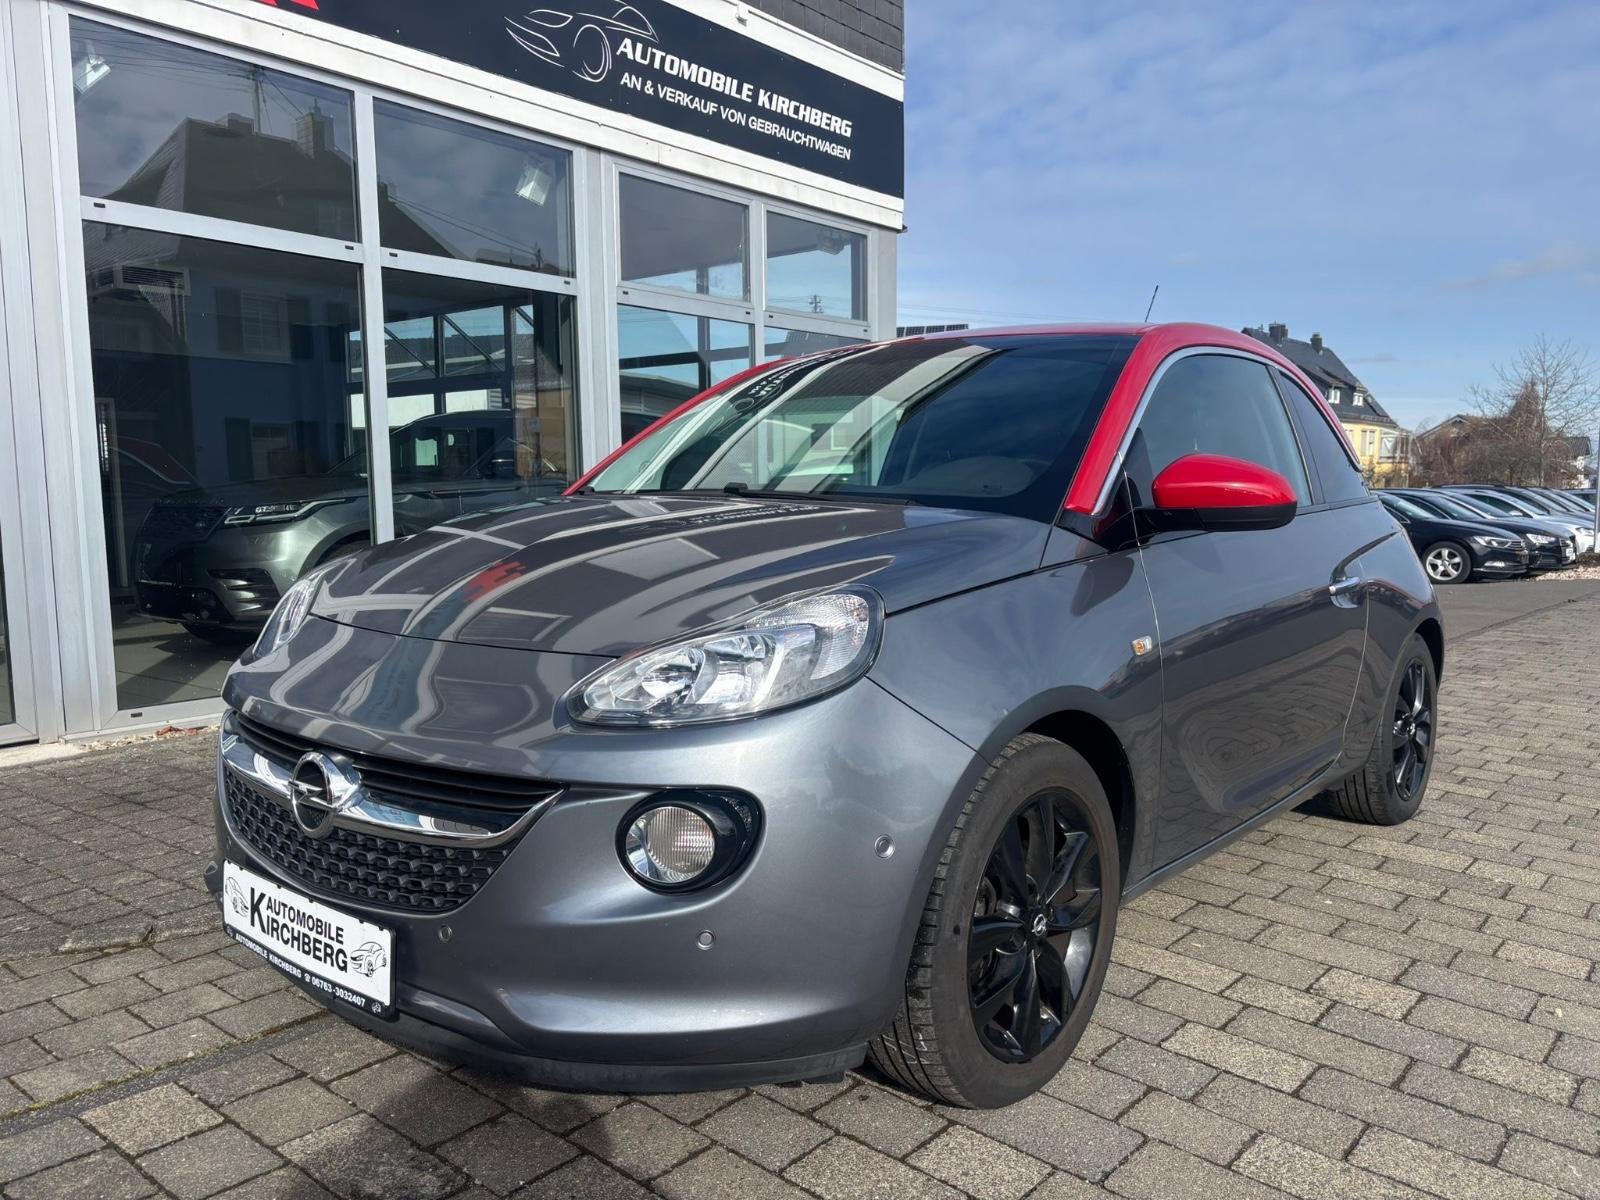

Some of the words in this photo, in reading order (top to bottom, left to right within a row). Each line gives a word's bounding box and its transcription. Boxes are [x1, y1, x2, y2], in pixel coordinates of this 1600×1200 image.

[616, 38, 753, 103] AUTOMOBILE
[757, 88, 853, 138] KIRCHBERG
[620, 72, 641, 90] AN
[645, 81, 654, 96] &
[657, 86, 718, 116] VERKAUF
[720, 106, 746, 126] VON
[748, 115, 851, 160] GEBRAUCHTWAGEN
[235, 934, 268, 959] AUTOMOBILE
[269, 952, 302, 978] KIRCHBERG
[250, 887, 348, 973] KIRCHBERG
[266, 897, 344, 945] AUTOMOBILE
